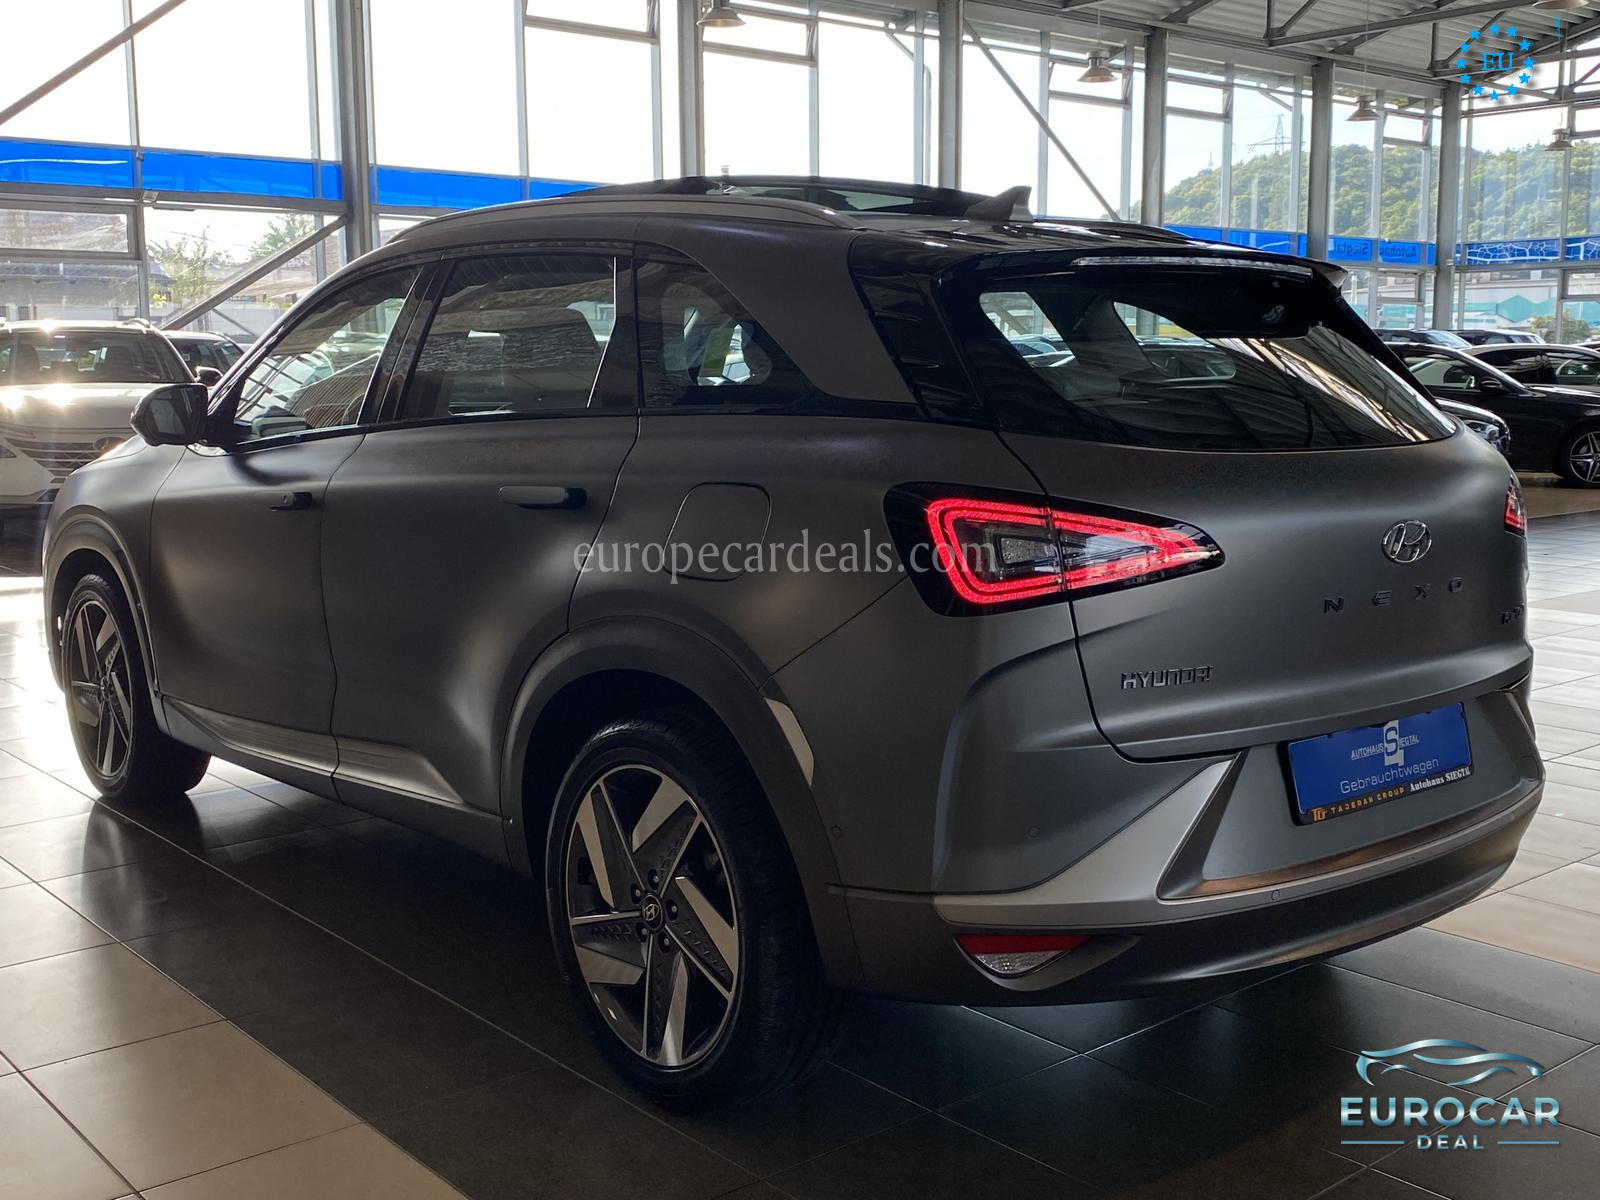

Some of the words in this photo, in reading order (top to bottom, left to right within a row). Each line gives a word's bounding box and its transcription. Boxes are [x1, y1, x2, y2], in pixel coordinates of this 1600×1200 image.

[1324, 576, 1463, 614] NEXO
[1121, 665, 1213, 690] HYUNDAI
[1351, 743, 1385, 760] AUTOHAUS
[1340, 758, 1439, 794] Gebrauchtwagen
[1410, 777, 1445, 792] Autohaus
